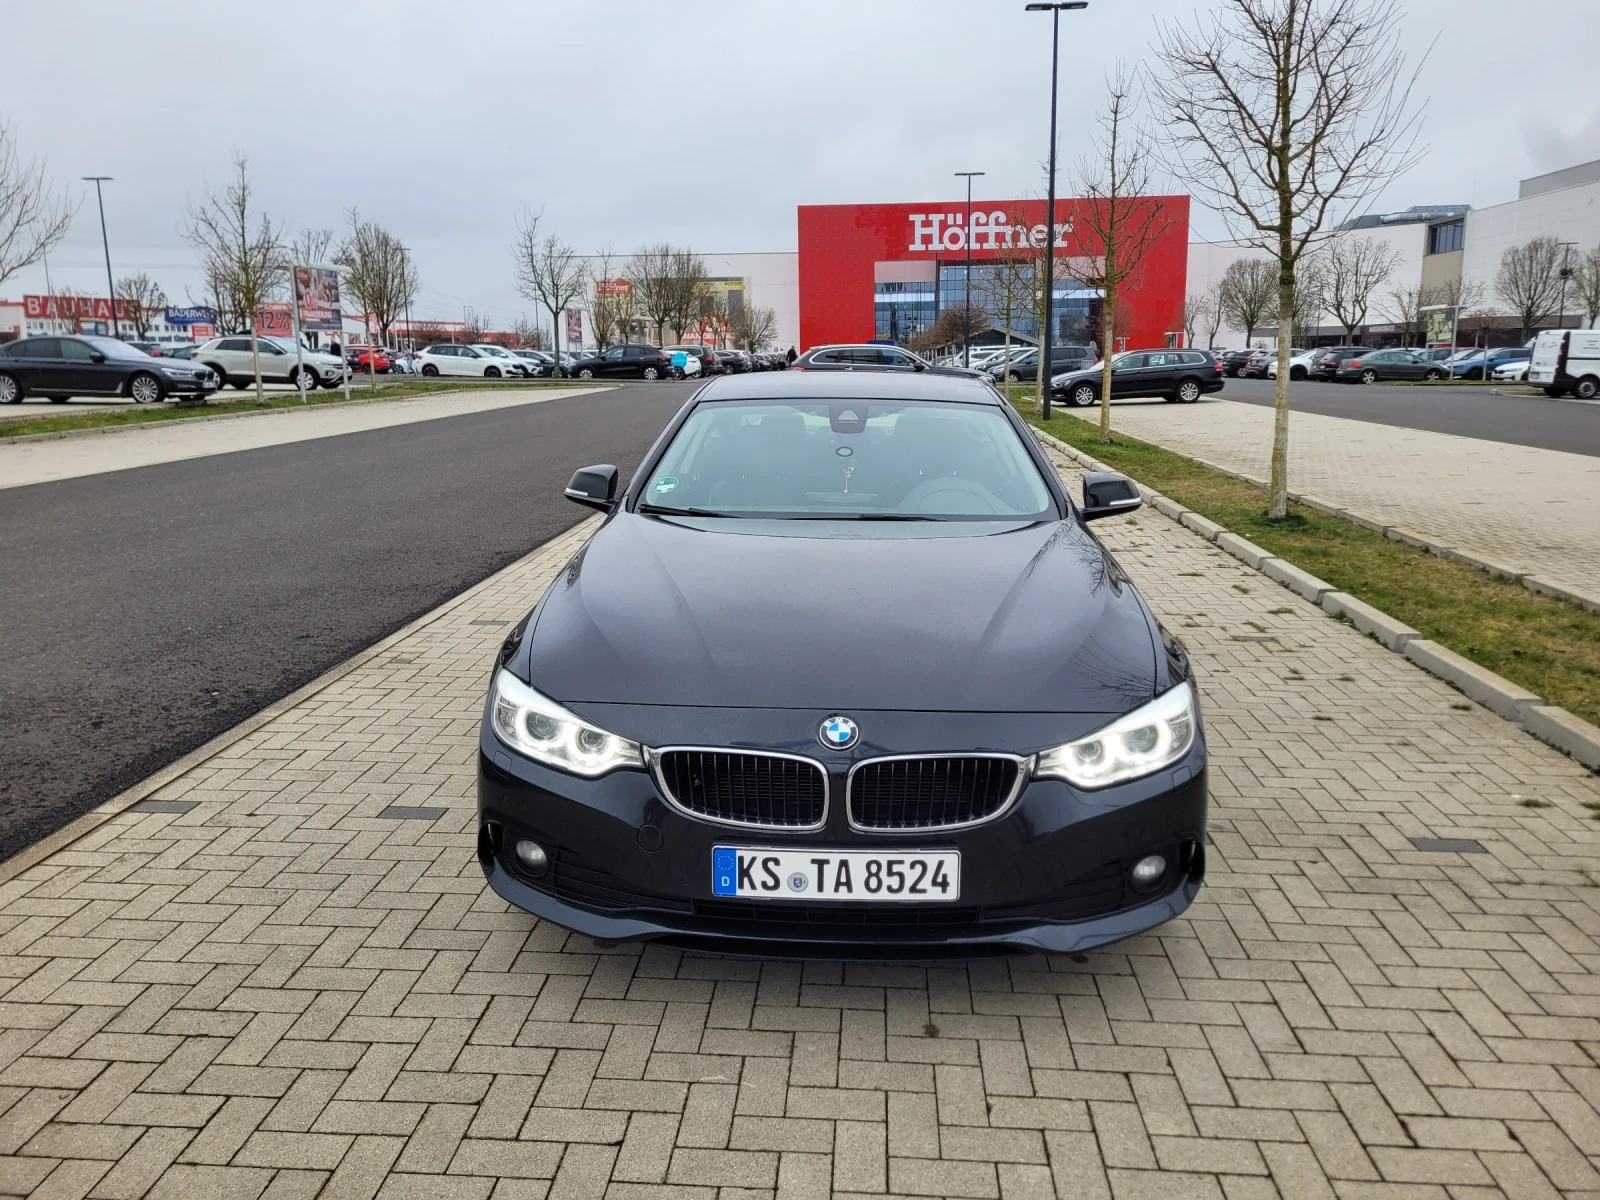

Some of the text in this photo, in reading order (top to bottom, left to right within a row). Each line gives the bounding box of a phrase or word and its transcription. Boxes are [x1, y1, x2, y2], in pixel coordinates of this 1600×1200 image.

[908, 211, 1073, 251] Höffner
[27, 298, 140, 318] BAUHAUS
[258, 311, 290, 330] 12%
[823, 717, 855, 728] BMW
[721, 877, 729, 888] D
[737, 855, 950, 894] KS TA 8524
